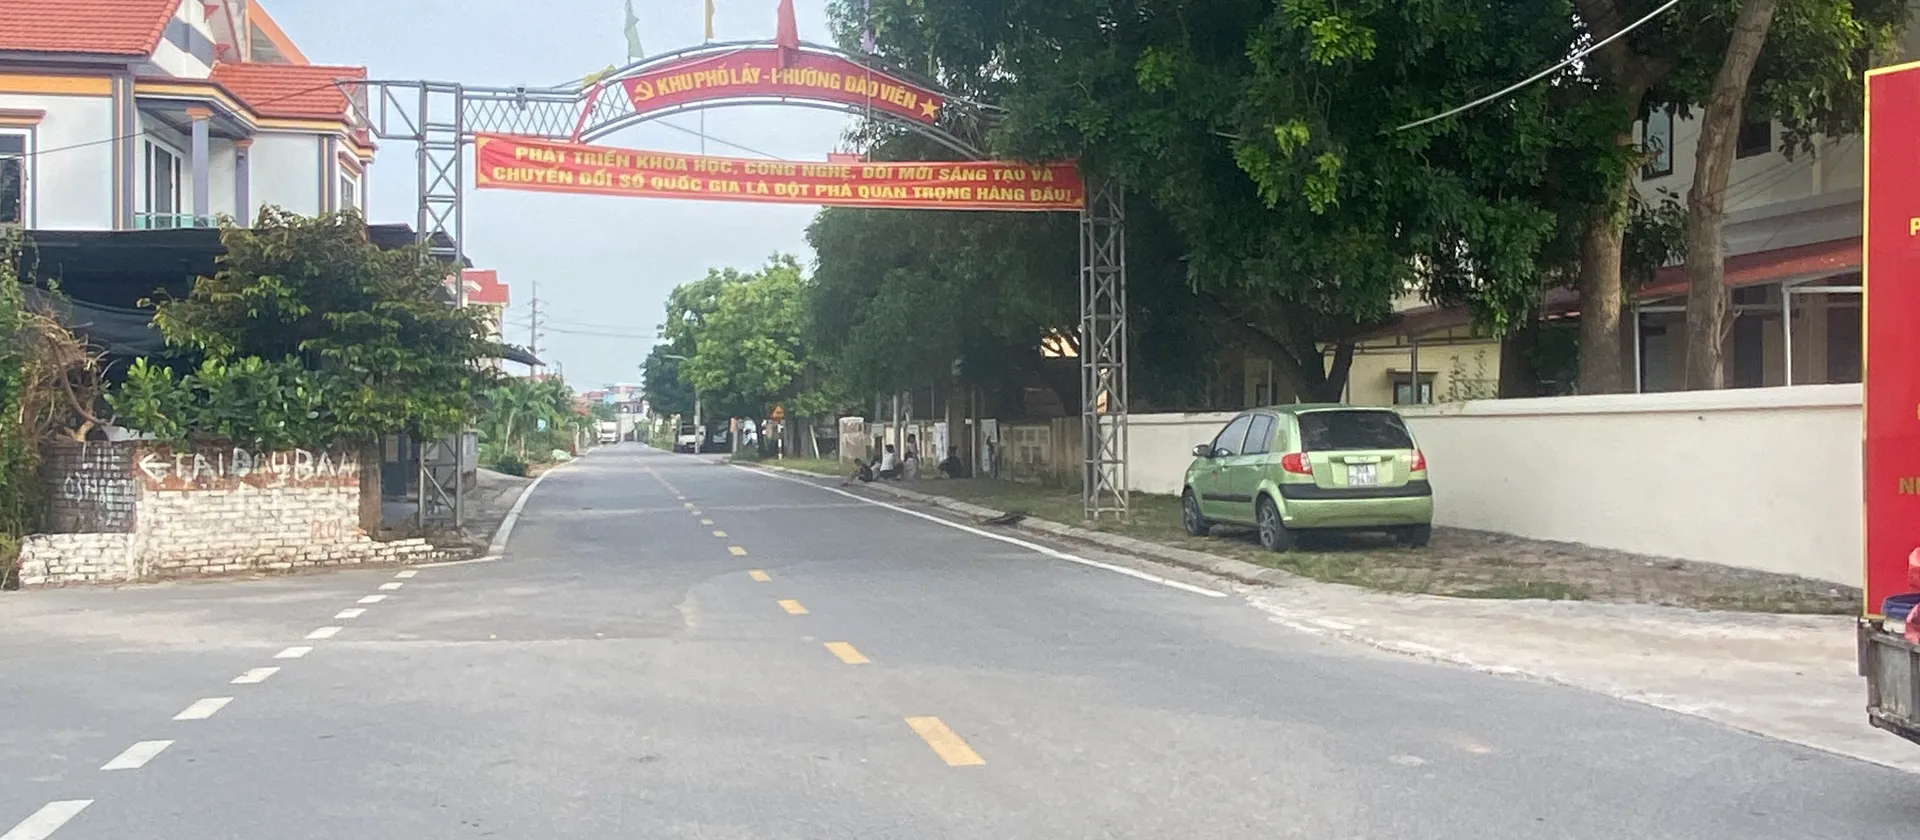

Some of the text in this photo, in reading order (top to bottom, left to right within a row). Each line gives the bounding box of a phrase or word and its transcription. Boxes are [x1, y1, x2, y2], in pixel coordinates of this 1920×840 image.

[656, 73, 694, 96] KHU
[694, 62, 730, 89] PHỐ
[880, 86, 918, 110] VIÊN
[515, 146, 567, 164] PHÁT
[574, 149, 631, 168] TRIỂN
[636, 154, 688, 171] KHOA
[693, 158, 739, 175] HỌC,
[744, 161, 796, 177] CÔNG
[898, 165, 934, 180] MỚI
[939, 166, 987, 182] SÁNG
[992, 168, 1026, 184] TẠO
[1030, 167, 1054, 182] VÀ
[492, 166, 574, 185] CHUYỂN
[578, 168, 613, 187] ĐỔI
[619, 172, 645, 188] SỐ
[650, 174, 702, 191] QUỐC
[708, 179, 740, 193] GIA
[746, 179, 769, 194] LÀ
[774, 181, 810, 199] ĐỘT
[815, 183, 852, 197] PHÁ
[858, 185, 907, 199] QUAN
[912, 186, 972, 203] TRỌNG
[976, 185, 1025, 201] HÀNG
